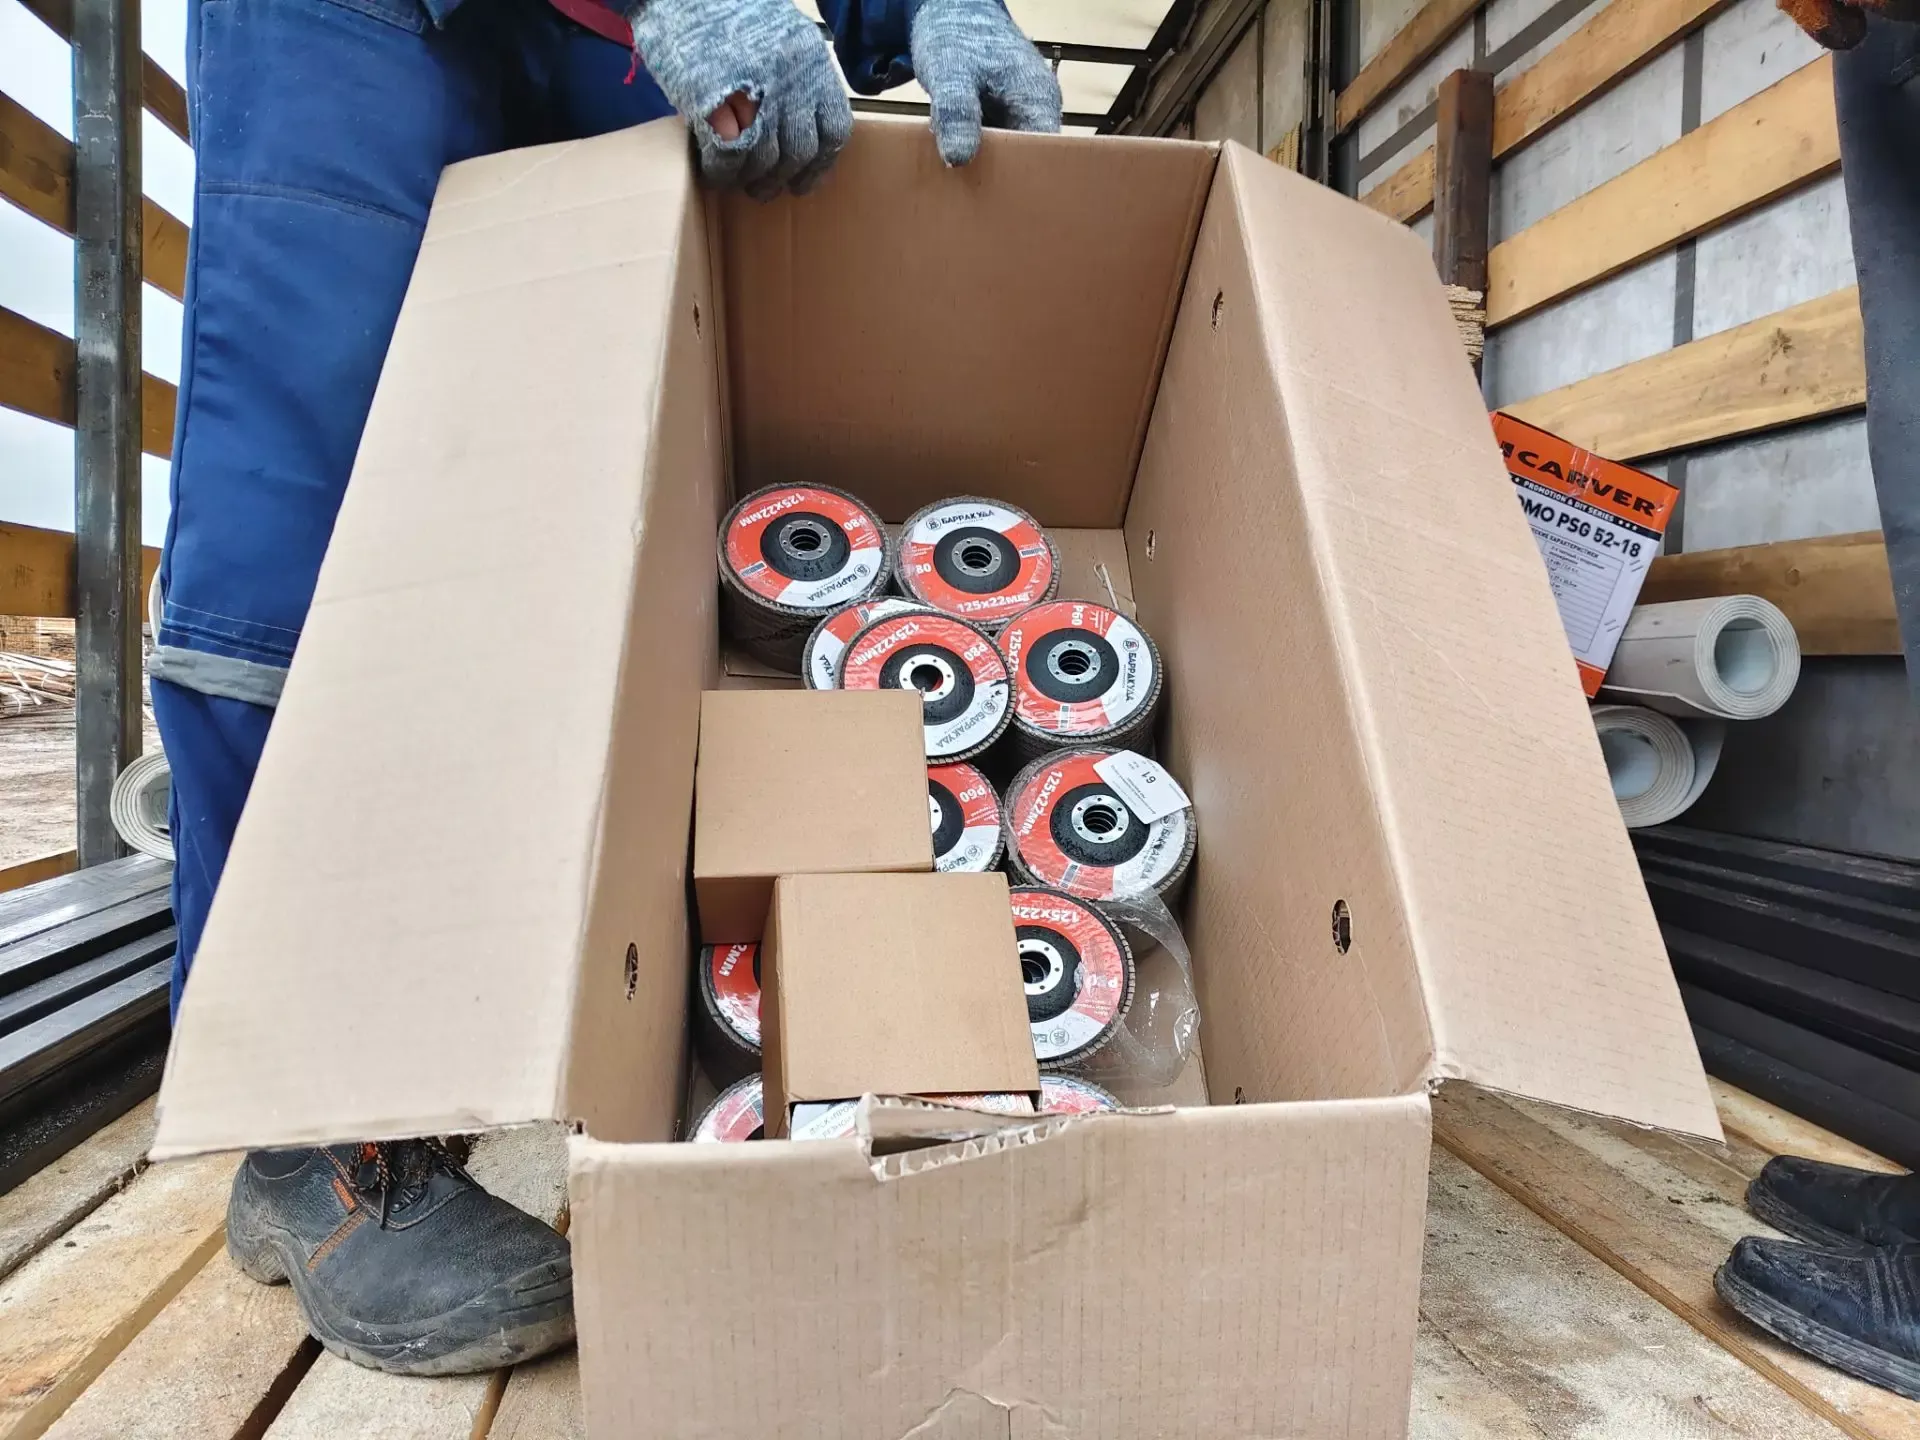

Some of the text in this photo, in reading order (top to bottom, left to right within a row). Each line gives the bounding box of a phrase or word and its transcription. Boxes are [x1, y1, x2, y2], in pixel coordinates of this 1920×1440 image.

[1517, 450, 1656, 517] CARVER
[1523, 480, 1567, 502] PROMOTION
[1588, 506, 1615, 522] SERIES
[1556, 512, 1592, 538] PSG
[1593, 526, 1642, 558] 52-18
[963, 642, 989, 662] P80
[1008, 629, 1023, 672] 125x22
[959, 785, 986, 803] P60
[1140, 771, 1157, 785] 61
